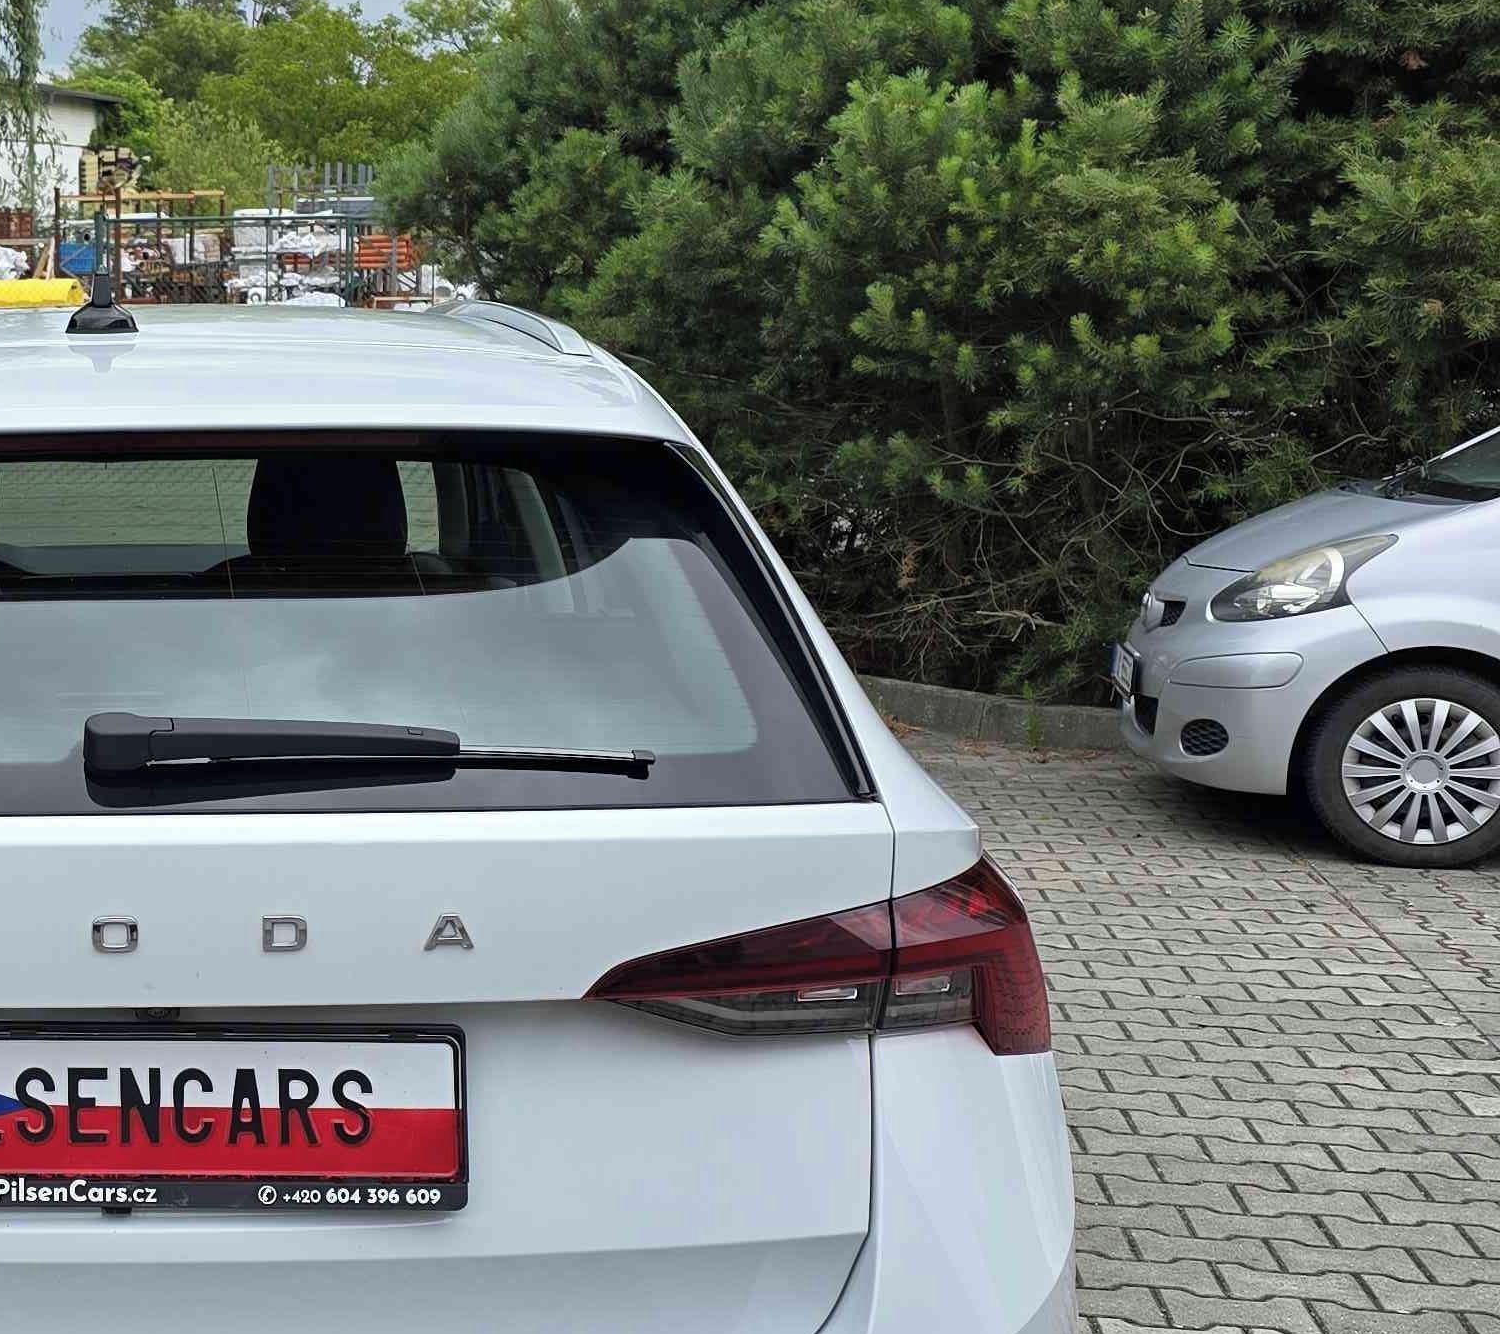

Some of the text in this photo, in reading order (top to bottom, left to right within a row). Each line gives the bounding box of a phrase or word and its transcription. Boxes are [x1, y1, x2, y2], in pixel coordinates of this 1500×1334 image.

[283, 1188, 441, 1204] +420 604 396 609
